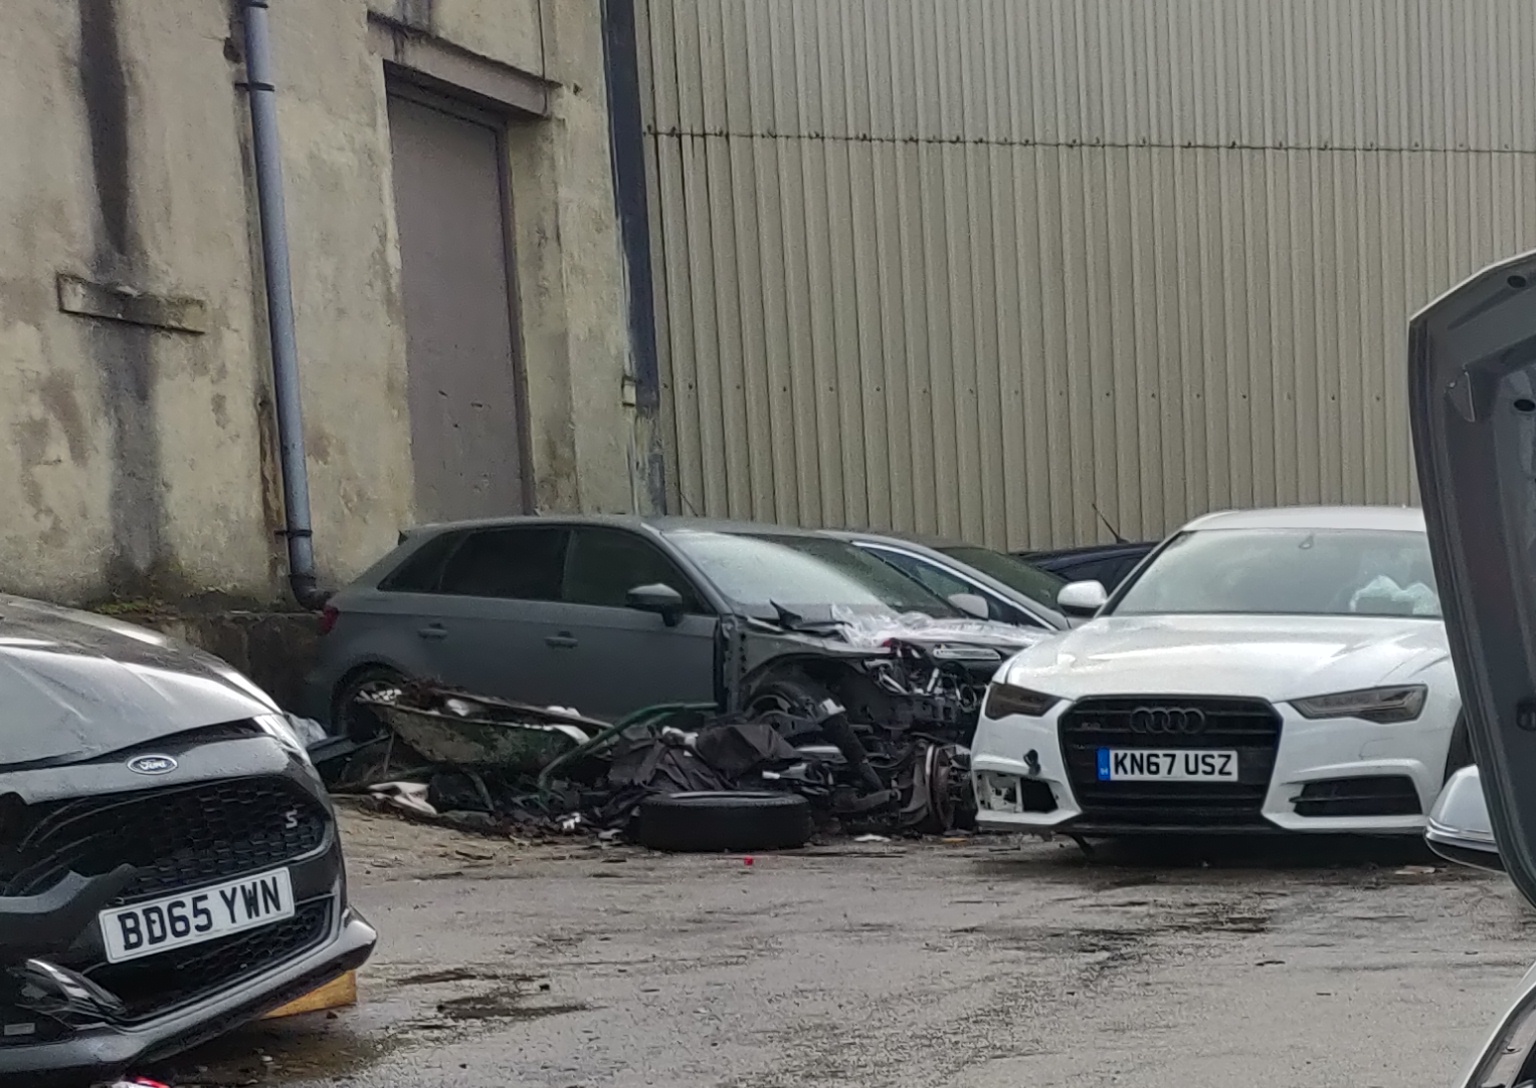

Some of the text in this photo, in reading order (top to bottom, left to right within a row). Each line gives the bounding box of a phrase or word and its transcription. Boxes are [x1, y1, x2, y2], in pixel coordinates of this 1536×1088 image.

[1113, 752, 1233, 776] KN67 USZ
[117, 875, 282, 951] BD65 YWN
